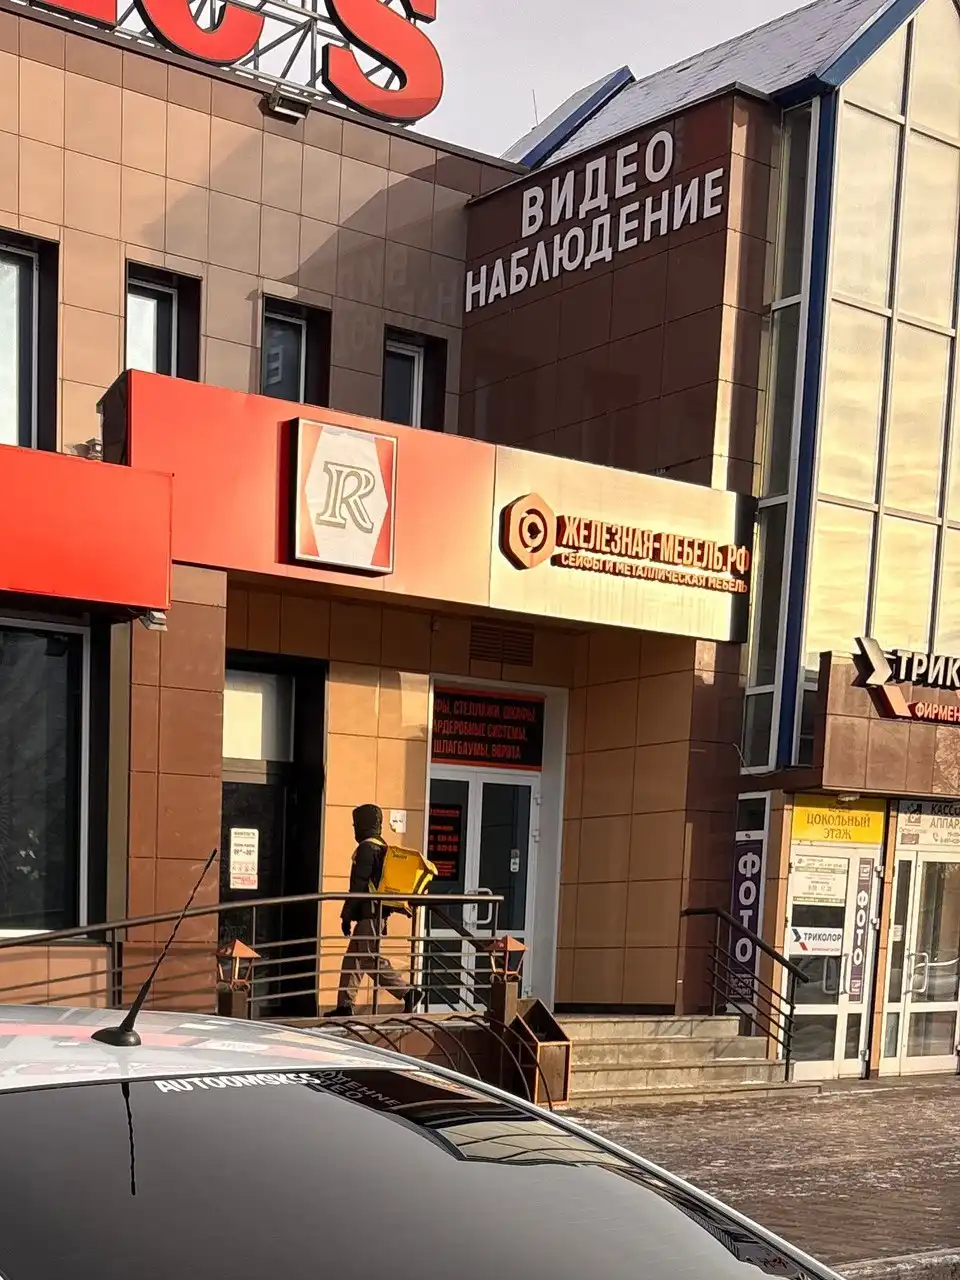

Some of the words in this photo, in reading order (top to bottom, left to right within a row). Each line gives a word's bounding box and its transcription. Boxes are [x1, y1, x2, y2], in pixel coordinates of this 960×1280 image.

[522, 130, 674, 239] ВИДЕО
[465, 167, 725, 313] НАБЛЮДЕНИЕ
[315, 460, 376, 534] R
[561, 552, 603, 570] СЕЙФЫ
[605, 560, 614, 572] И
[615, 562, 707, 587] МЕТАЛЛИЧЕСКАЯ
[707, 576, 748, 593] МЕБЕЛЬ
[562, 514, 750, 575] ЖЕЛЕЗНАЯ-МЕБЕЛЬ.РФ
[806, 813, 871, 828] ЦОКОЛЬНЫЙ
[929, 816, 960, 829] АППАР
[735, 851, 761, 963] ФОТО
[803, 932, 842, 942] ТРИКОЛОР
[853, 890, 869, 966] ФОТО
